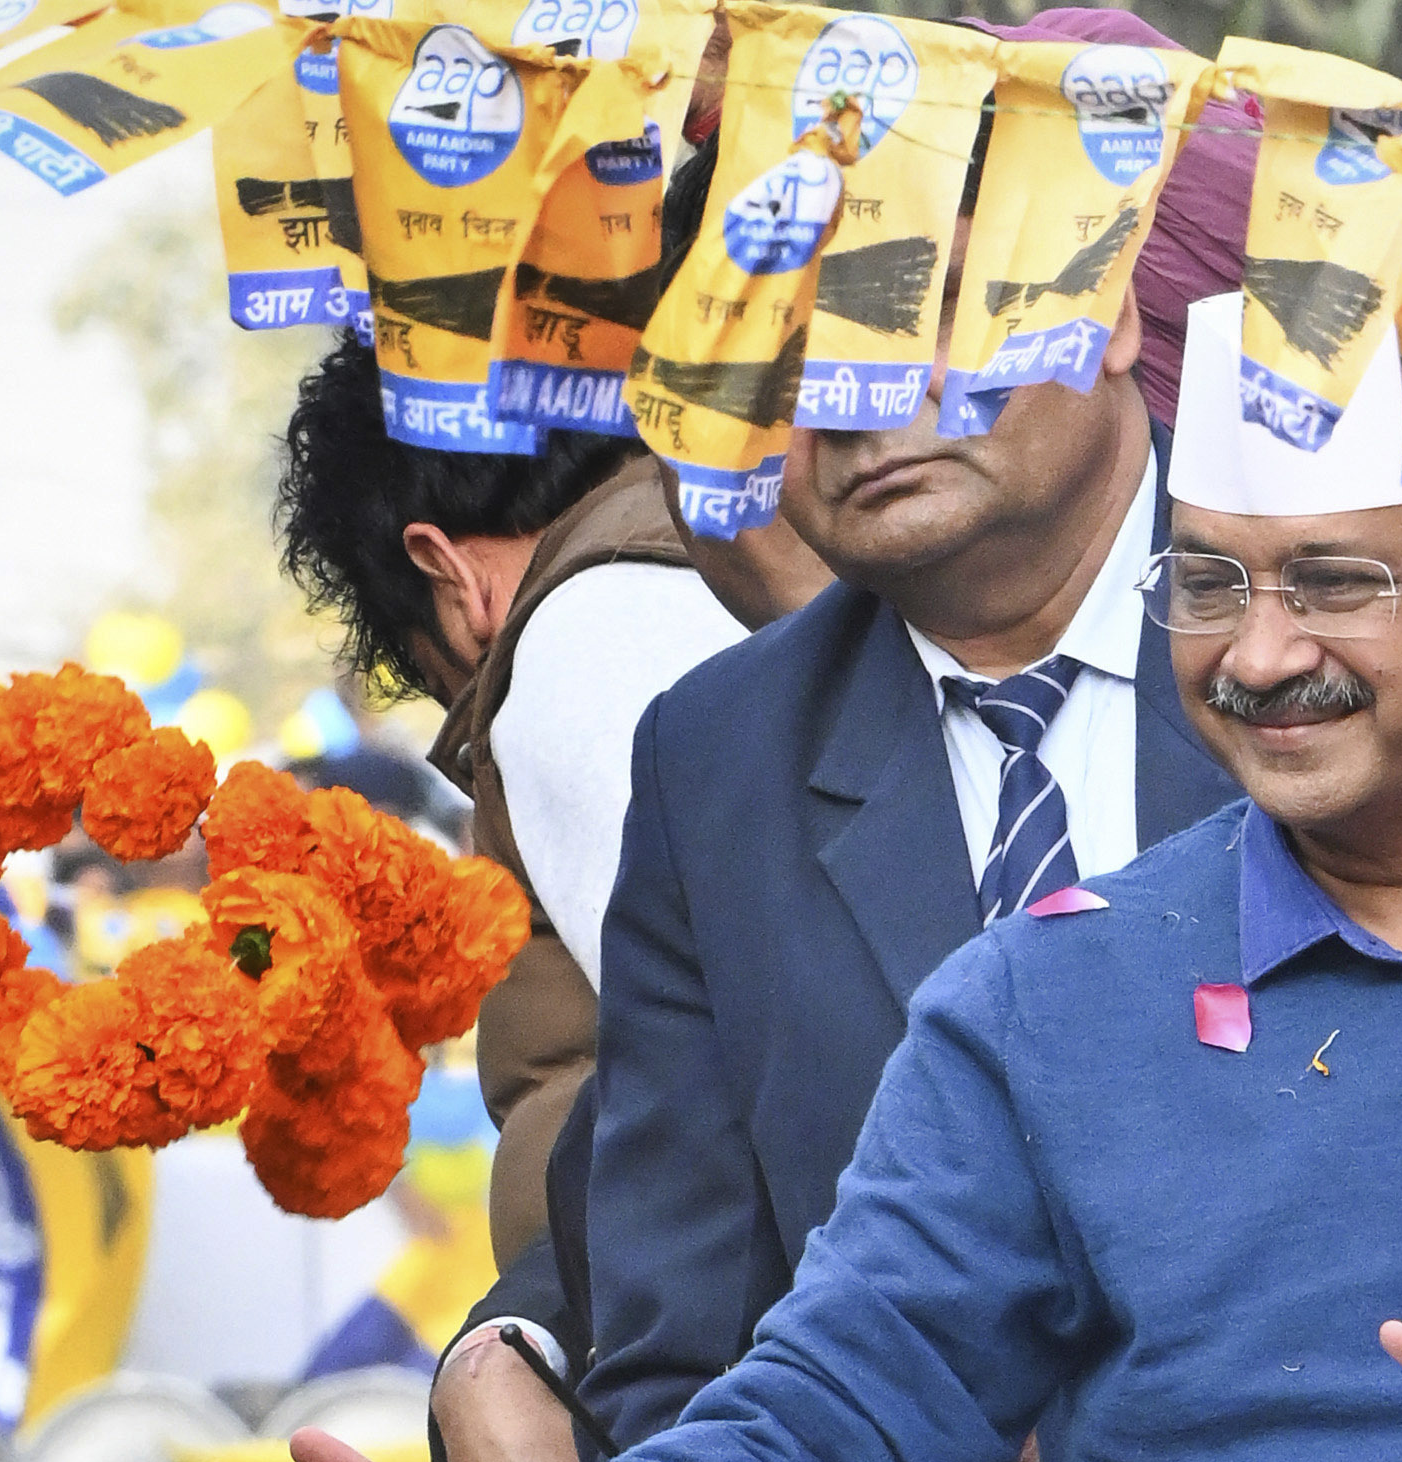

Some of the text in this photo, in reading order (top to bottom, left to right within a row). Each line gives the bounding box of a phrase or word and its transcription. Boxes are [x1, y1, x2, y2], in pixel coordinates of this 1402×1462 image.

[301, 62, 339, 80] PART
[417, 54, 506, 131] aap
[815, 47, 910, 114] aap
[423, 152, 472, 174] PARTY
[1135, 139, 1162, 155] AAD
[278, 215, 331, 255] झा
[397, 209, 444, 239] चुनाव
[245, 288, 315, 324] आम
[1044, 322, 1098, 373] पार्टी
[537, 371, 626, 424] AADMI
[798, 366, 925, 417] दमी पार्टी
[635, 390, 691, 455] झाडू
